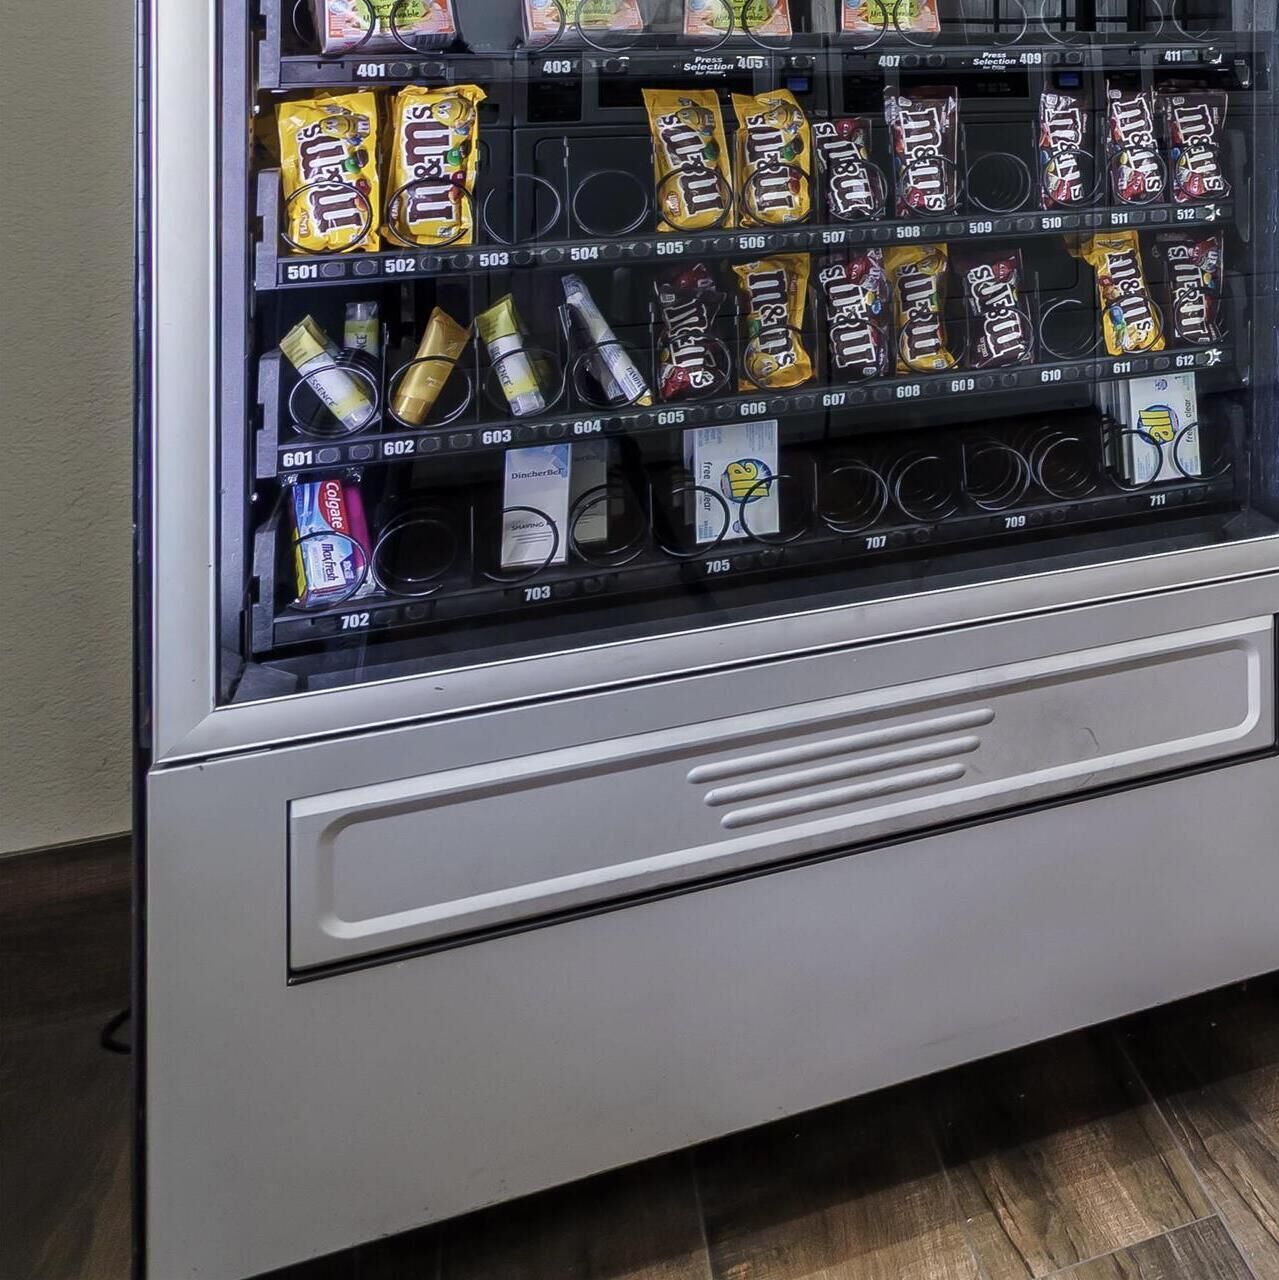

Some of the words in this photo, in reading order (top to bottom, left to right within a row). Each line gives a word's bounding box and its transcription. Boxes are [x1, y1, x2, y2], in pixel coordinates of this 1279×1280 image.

[879, 55, 900, 67] 407
[1020, 53, 1042, 64] 409
[1164, 50, 1181, 61] 411
[357, 64, 385, 77] 401
[543, 61, 571, 74] 403
[683, 63, 734, 71] Selection
[1111, 213, 1129, 224] 511
[1177, 209, 1195, 220] 512
[969, 222, 993, 234] 509
[1042, 217, 1062, 229] 510
[823, 232, 846, 243] 507
[896, 226, 921, 238] 508
[656, 242, 684, 254] 505
[739, 237, 765, 249] 506
[479, 253, 509, 266] 503
[571, 248, 599, 260] 504
[288, 265, 318, 279] 501
[385, 259, 415, 272] 502
[1113, 362, 1131, 373] 611
[1176, 355, 1195, 367] 612
[1041, 370, 1062, 382] 610
[897, 385, 920, 398] 608
[951, 379, 975, 392] 609
[823, 393, 846, 406] 607
[740, 402, 767, 415] 606
[1184, 399, 1192, 418] clear
[658, 411, 685, 425] 605
[574, 420, 601, 434] 604
[483, 430, 512, 444] 603
[384, 440, 414, 455] 602
[283, 451, 313, 467] 601
[703, 461, 712, 480] free
[325, 481, 343, 529] Colgate
[1150, 495, 1166, 506] 711
[1005, 516, 1026, 528] 709
[866, 536, 887, 550] 707
[706, 559, 731, 573] 705
[525, 586, 550, 601] 703
[341, 613, 369, 629] 702
